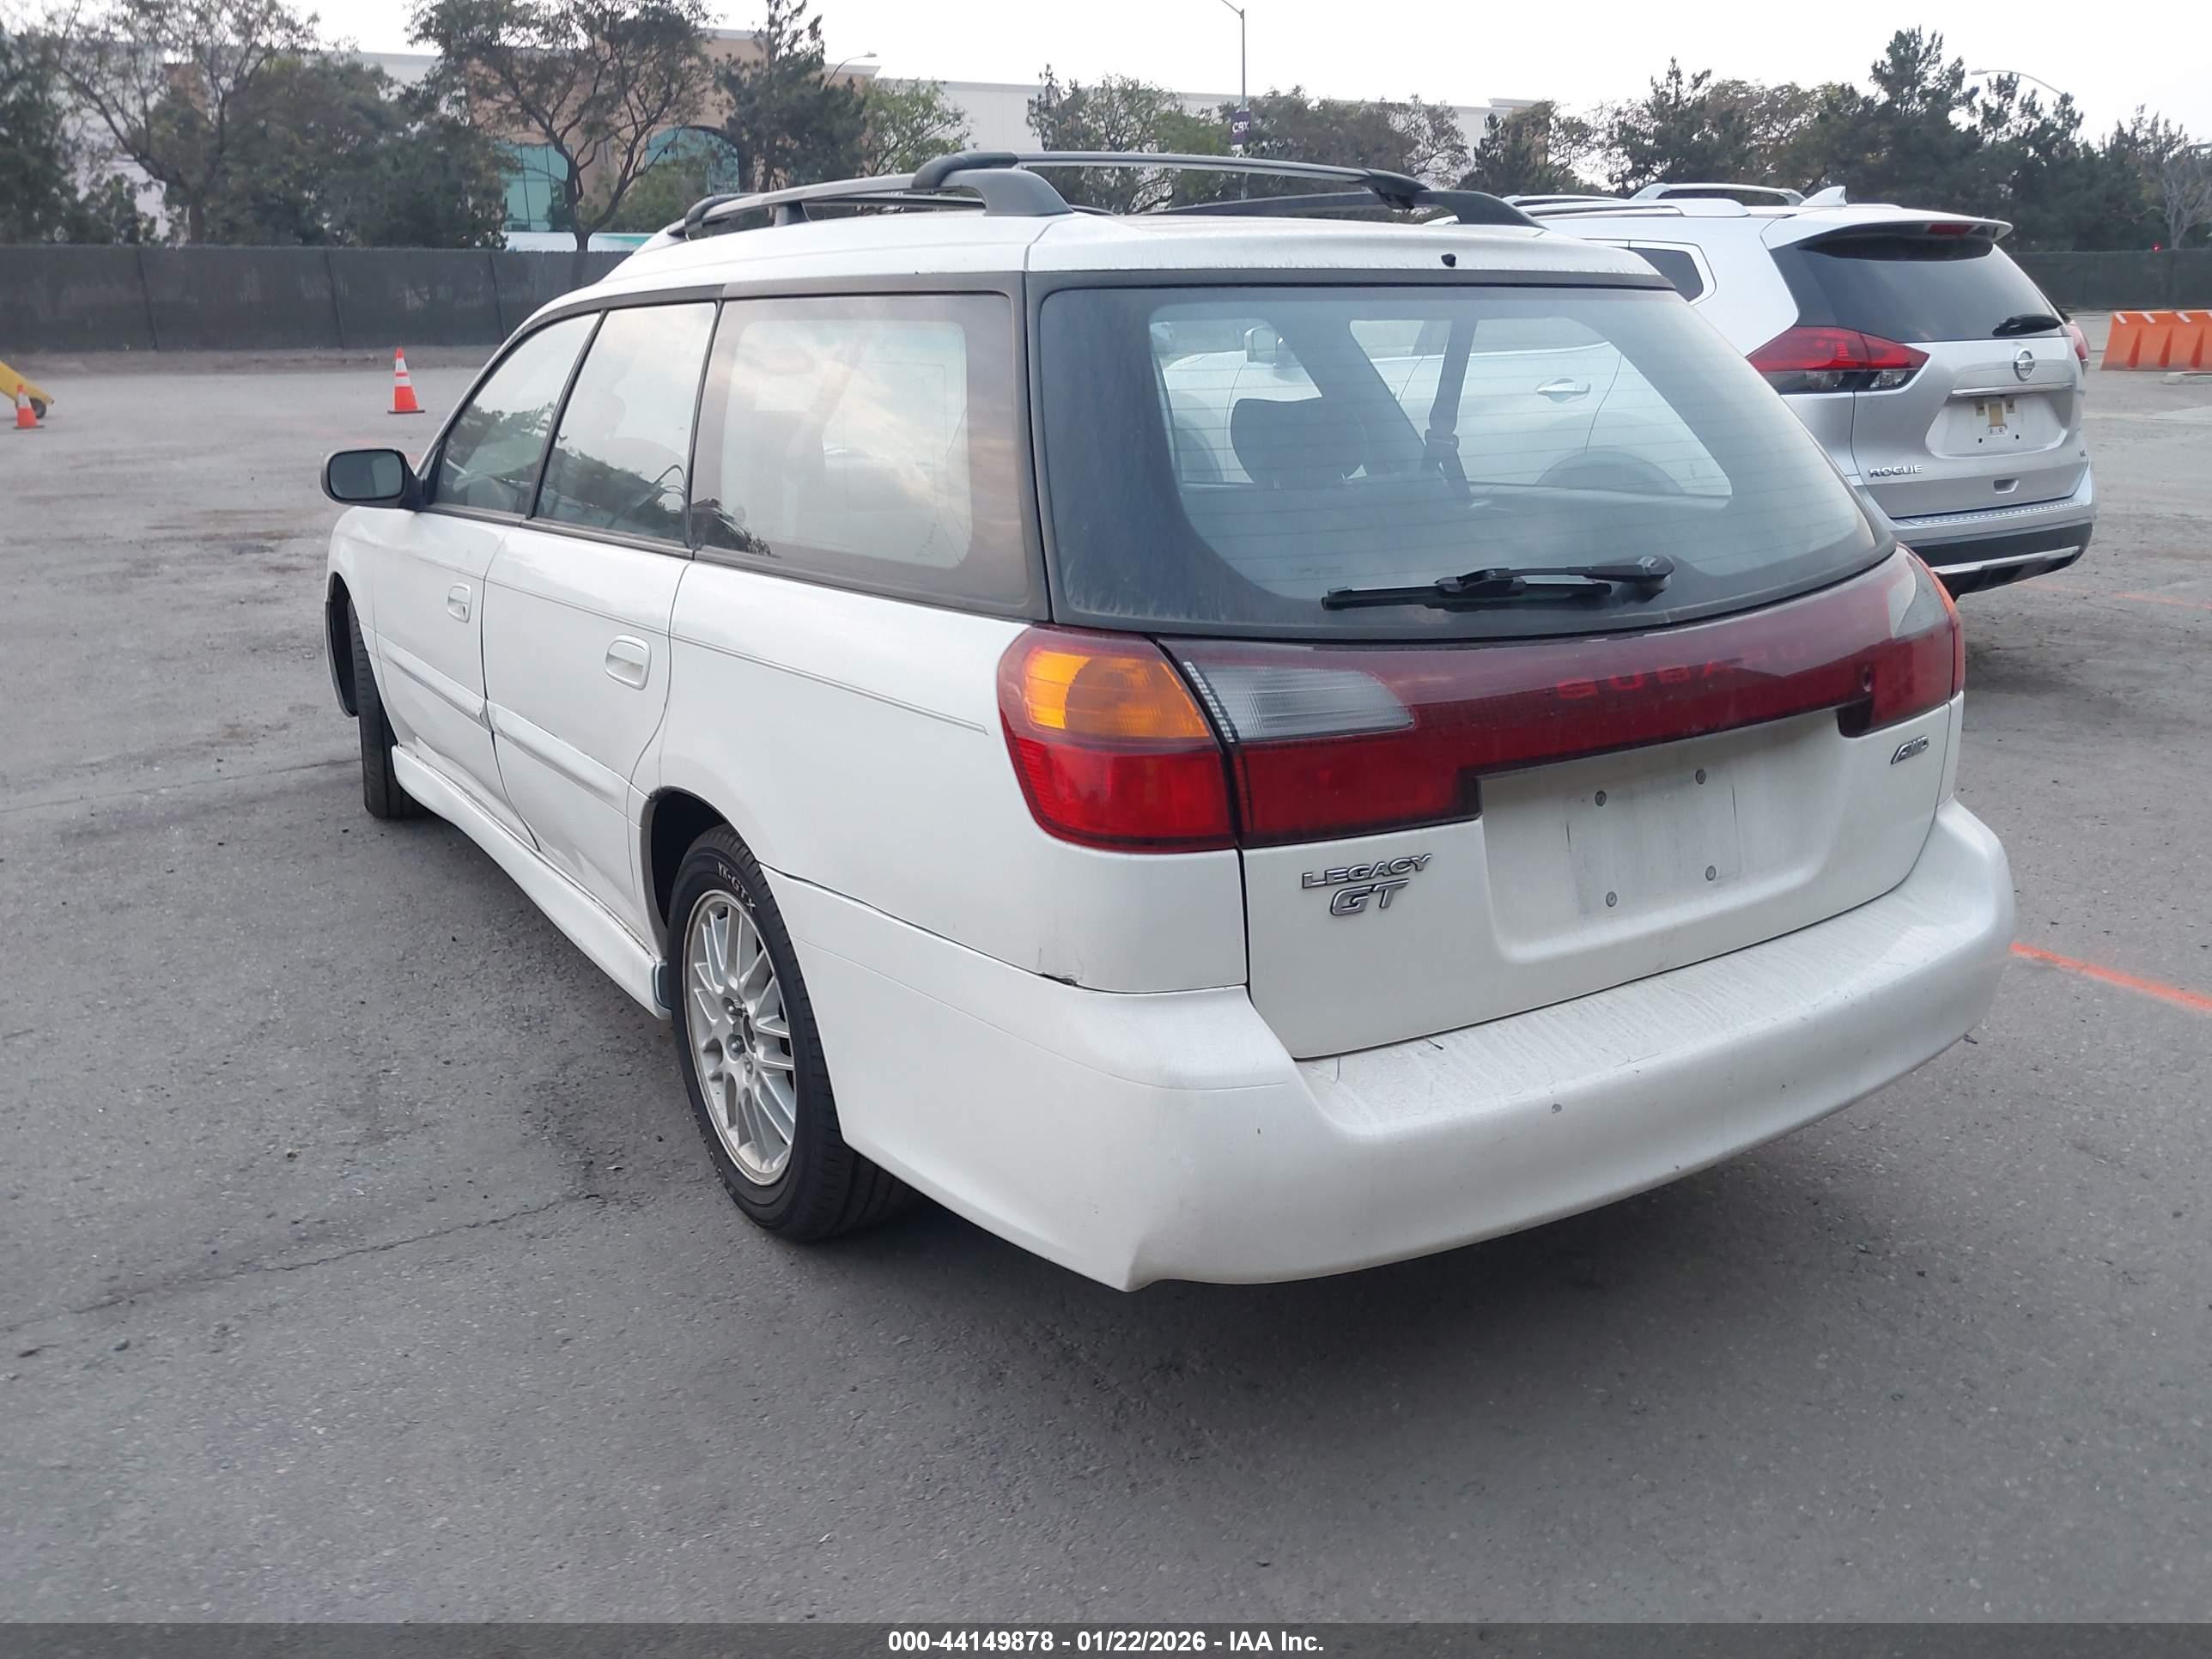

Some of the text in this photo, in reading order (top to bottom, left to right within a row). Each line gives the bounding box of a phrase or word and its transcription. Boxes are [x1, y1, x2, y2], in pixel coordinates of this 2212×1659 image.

[1869, 465, 1923, 477] ROGUE
[1890, 735, 1929, 764] AWD
[1302, 854, 1432, 889] LEGACY
[1330, 878, 1409, 915] GT
